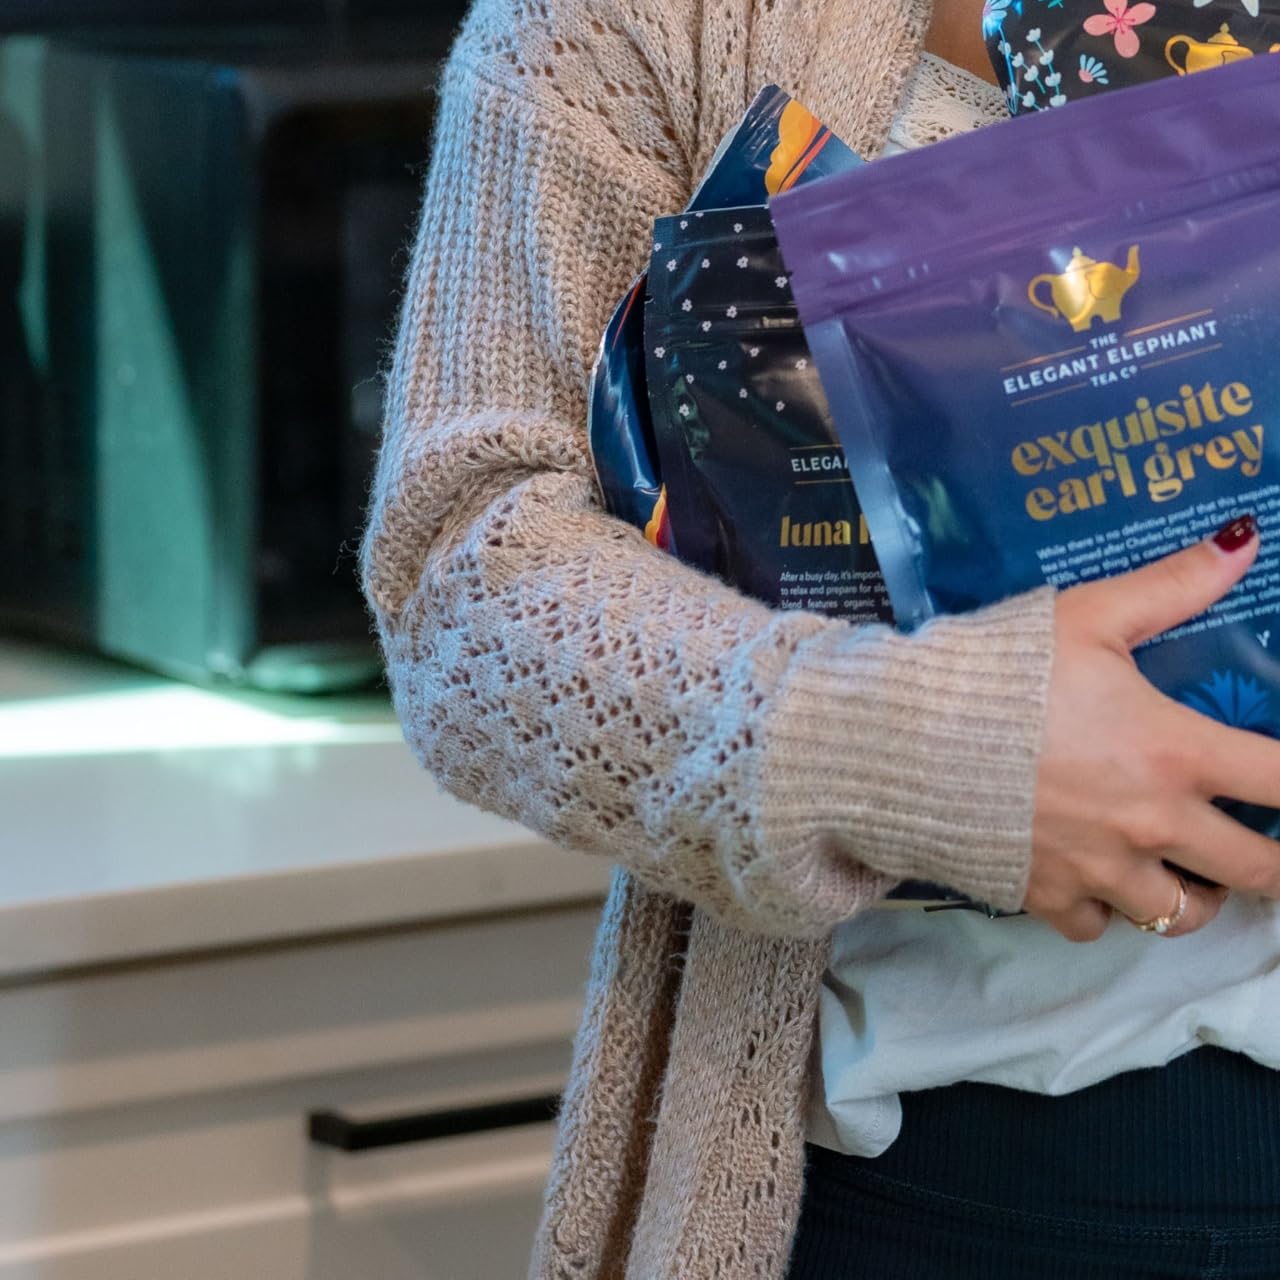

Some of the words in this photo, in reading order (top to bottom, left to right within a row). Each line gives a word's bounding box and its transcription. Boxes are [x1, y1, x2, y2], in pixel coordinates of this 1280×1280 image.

[1003, 354, 1100, 395] ELEGANT
[1106, 320, 1218, 366] ELEPHANT
[1089, 332, 1118, 350] THE
[1090, 374, 1118, 388] TEA
[1011, 381, 1253, 476] exquisite
[1025, 452, 1137, 521] earl
[1144, 424, 1264, 502] grey
[780, 515, 851, 548] luna
[780, 570, 799, 582] After
